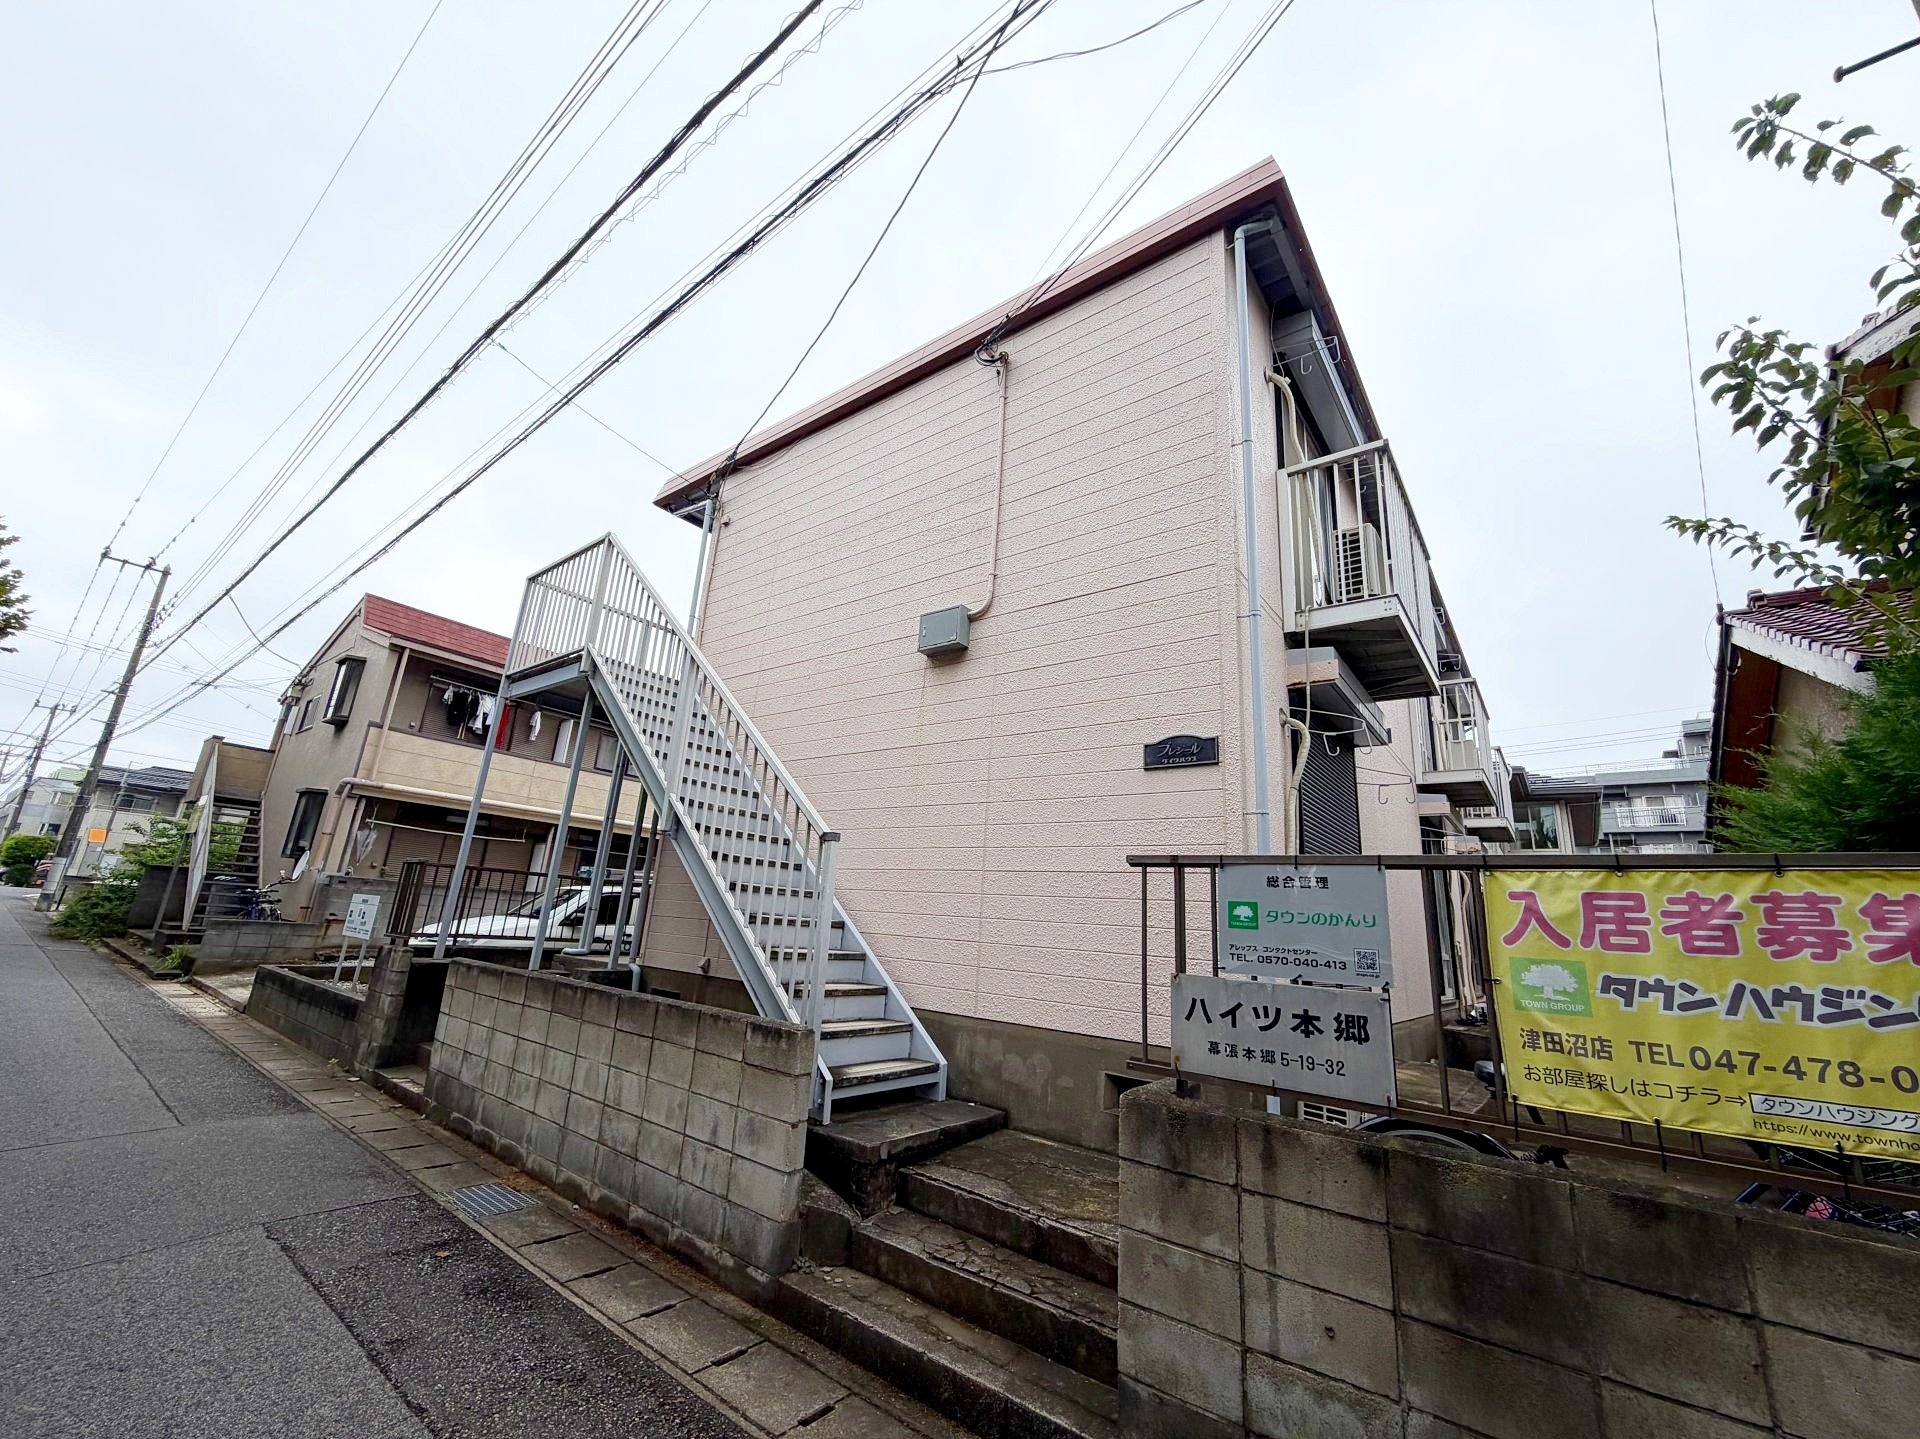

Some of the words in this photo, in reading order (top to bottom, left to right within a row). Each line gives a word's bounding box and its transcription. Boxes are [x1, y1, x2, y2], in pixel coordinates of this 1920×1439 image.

[1266, 875, 1329, 889] 総合管理
[1265, 910, 1377, 928] タウンのかんり
[1502, 890, 1920, 967] 入居者募集
[1229, 953, 1254, 963] TEL.
[1257, 955, 1347, 970] 0570-040-413
[1262, 946, 1318, 956] コンタクトセンター
[1520, 1000, 1548, 1011] TOWN
[1550, 1002, 1585, 1013] GROUP
[1600, 975, 1920, 1029] タウンハウジン
[1184, 997, 1370, 1045] ハイツ本郷
[1519, 1028, 1614, 1062] 津田沼店
[1761, 1097, 1920, 1130] タウンハウジング
